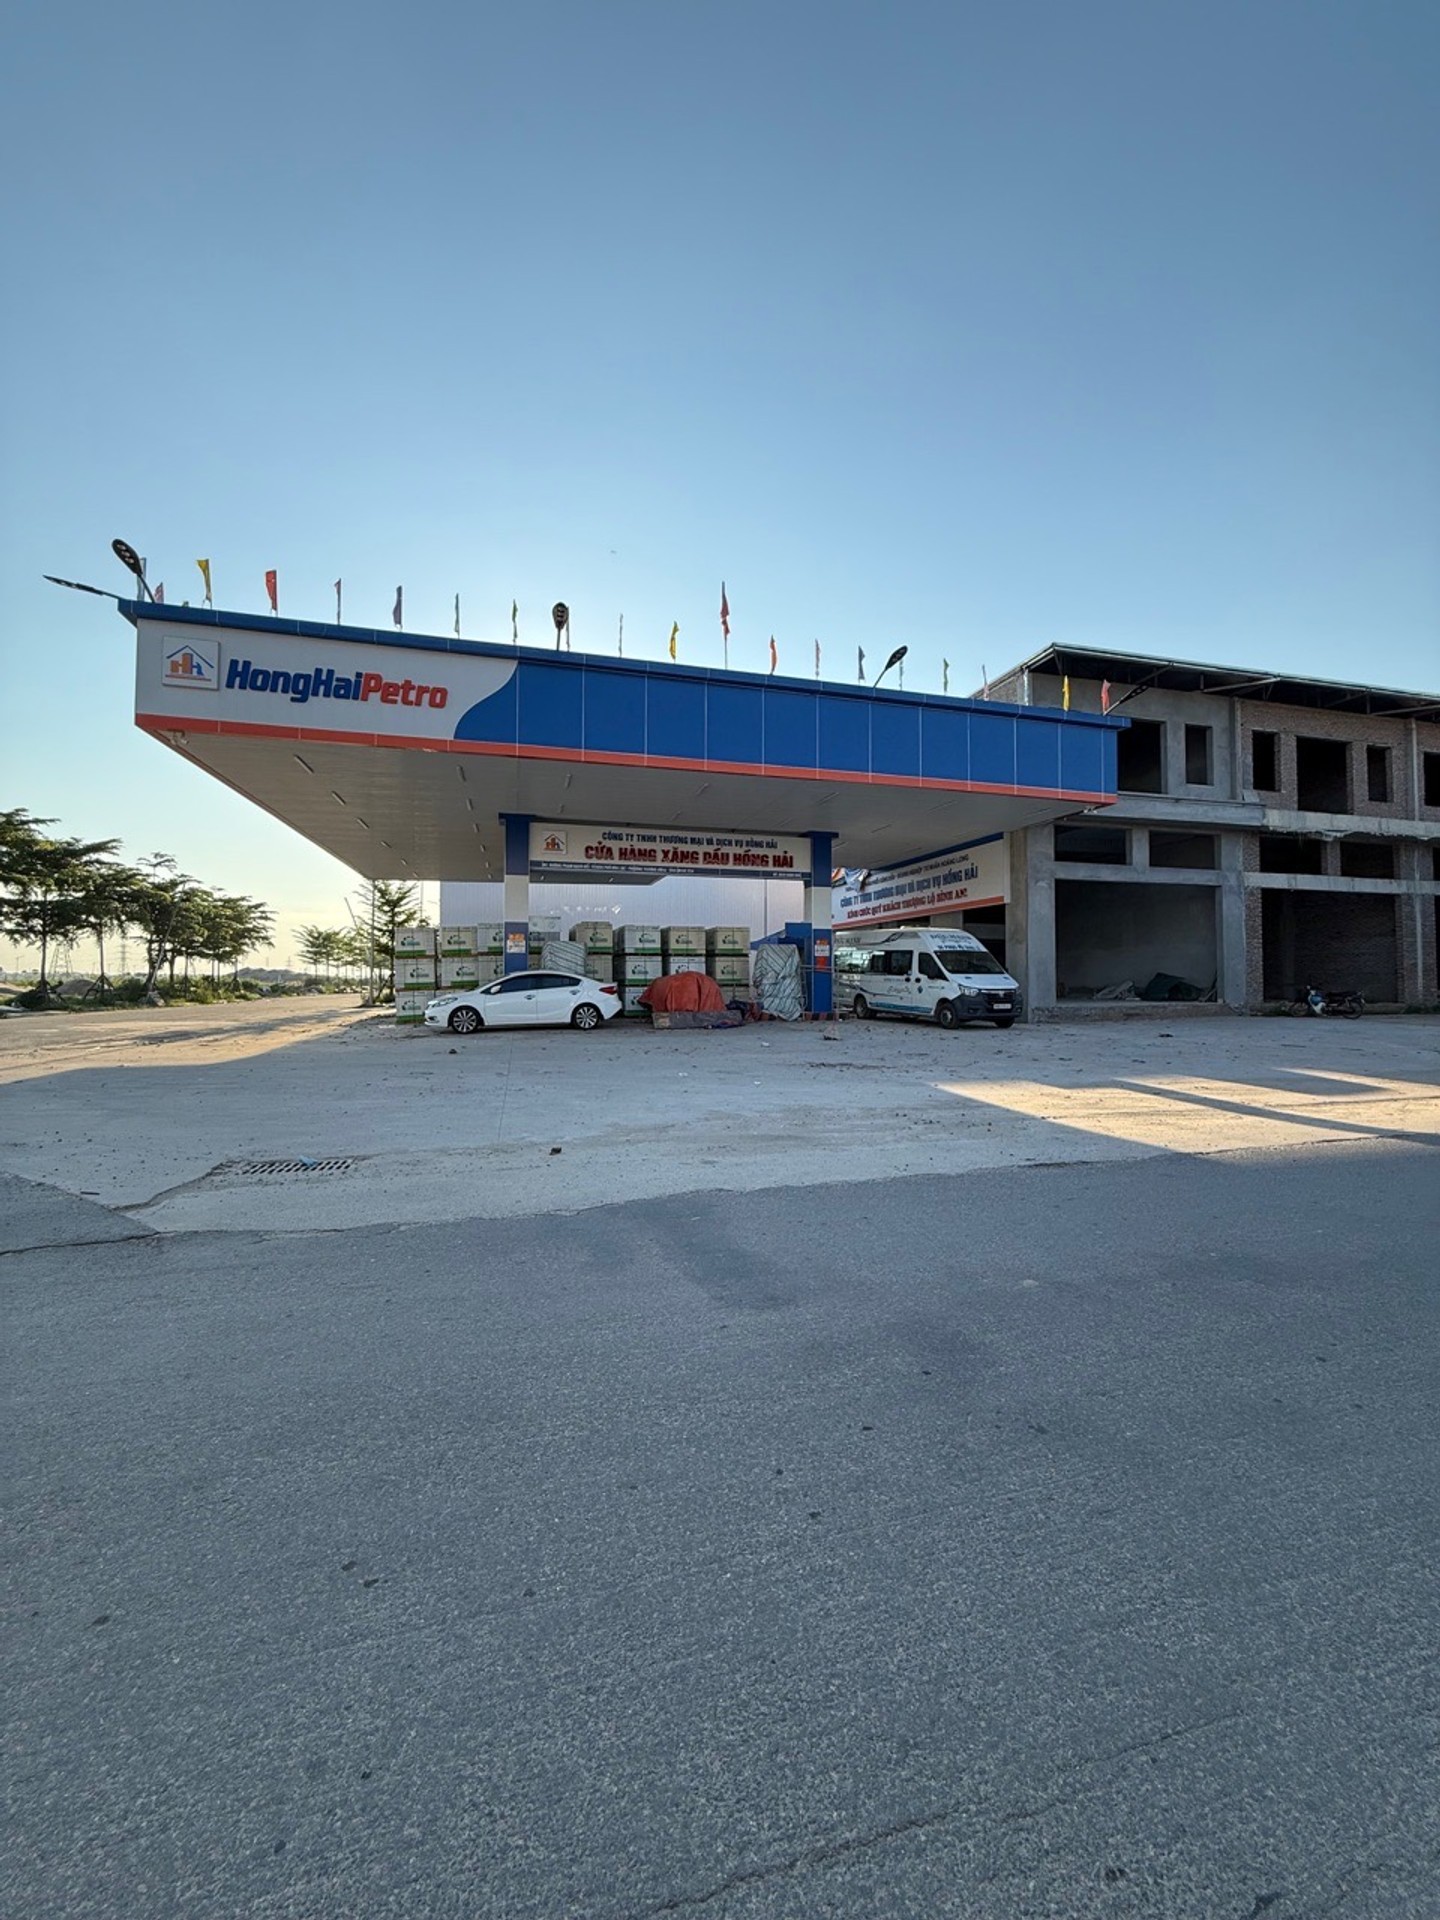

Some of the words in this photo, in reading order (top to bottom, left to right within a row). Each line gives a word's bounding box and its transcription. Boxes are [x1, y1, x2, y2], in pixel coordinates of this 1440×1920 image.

[225, 658, 449, 709] HongHaiPetro
[602, 830, 623, 842] CÔNG
[625, 833, 634, 842] TY
[636, 834, 657, 843] TNHH
[659, 834, 688, 845] THƯƠNG
[690, 836, 704, 847] MẠI
[716, 838, 733, 848] DỊCH
[585, 840, 614, 861] CỬA
[618, 844, 657, 862] HÀNG
[661, 846, 699, 865] XĂNG
[773, 850, 794, 868] HẢI
